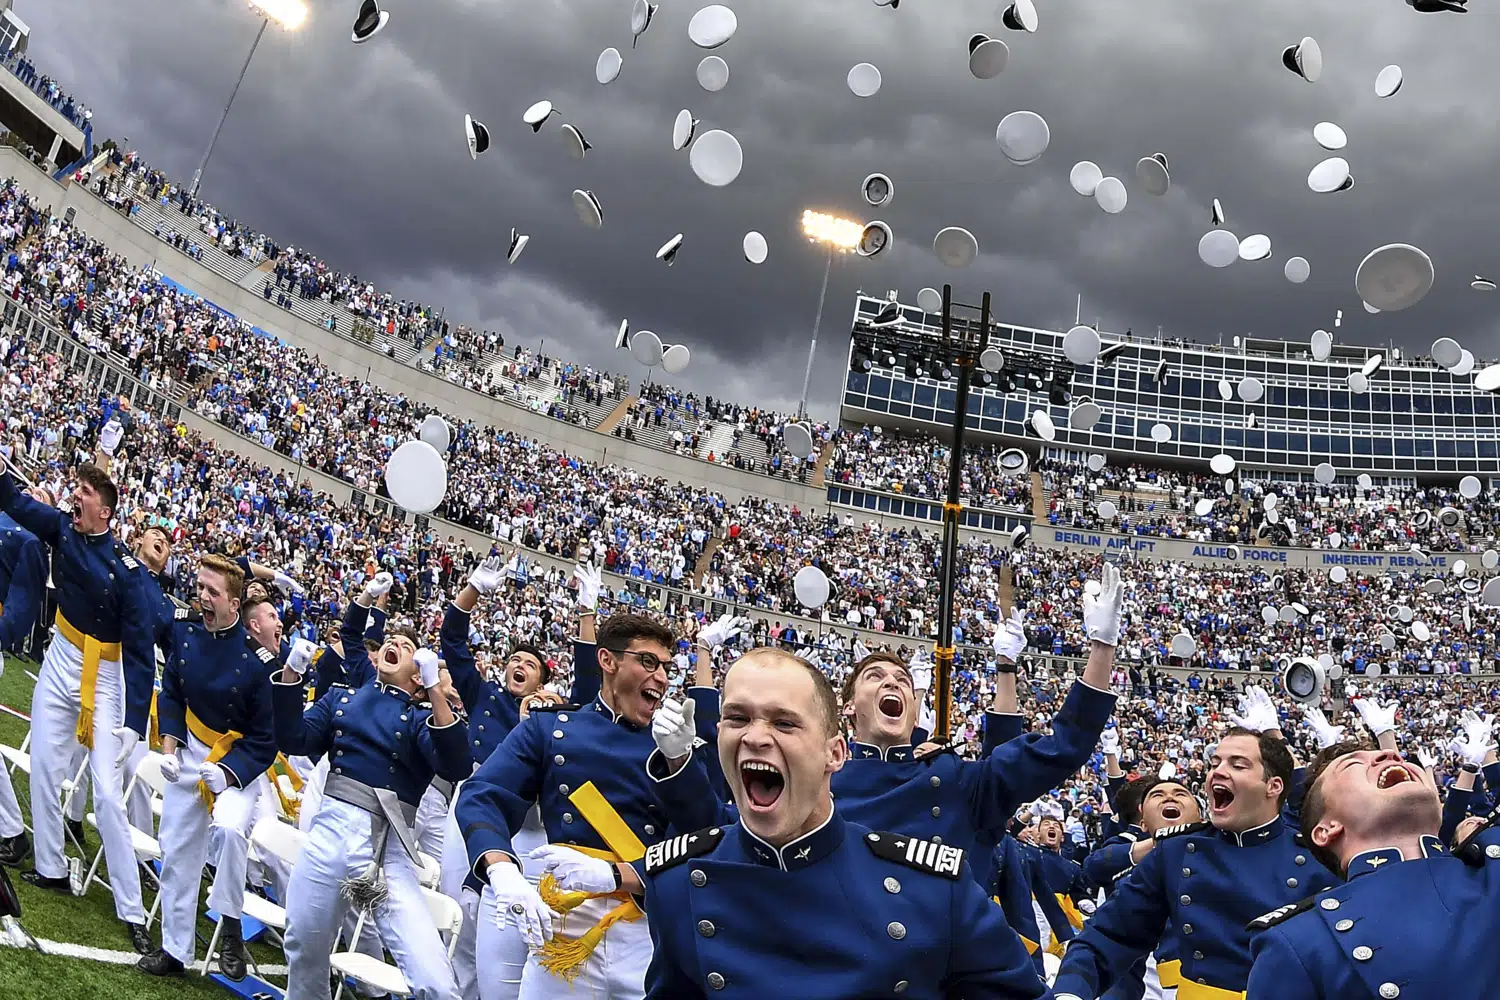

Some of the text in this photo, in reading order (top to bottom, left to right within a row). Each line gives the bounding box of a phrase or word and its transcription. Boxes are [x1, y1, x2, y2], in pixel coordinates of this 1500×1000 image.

[1054, 531, 1101, 546] BERLIN
[1192, 545, 1287, 561] ALLIE FORCE
[1322, 553, 1384, 566] INHERENT
